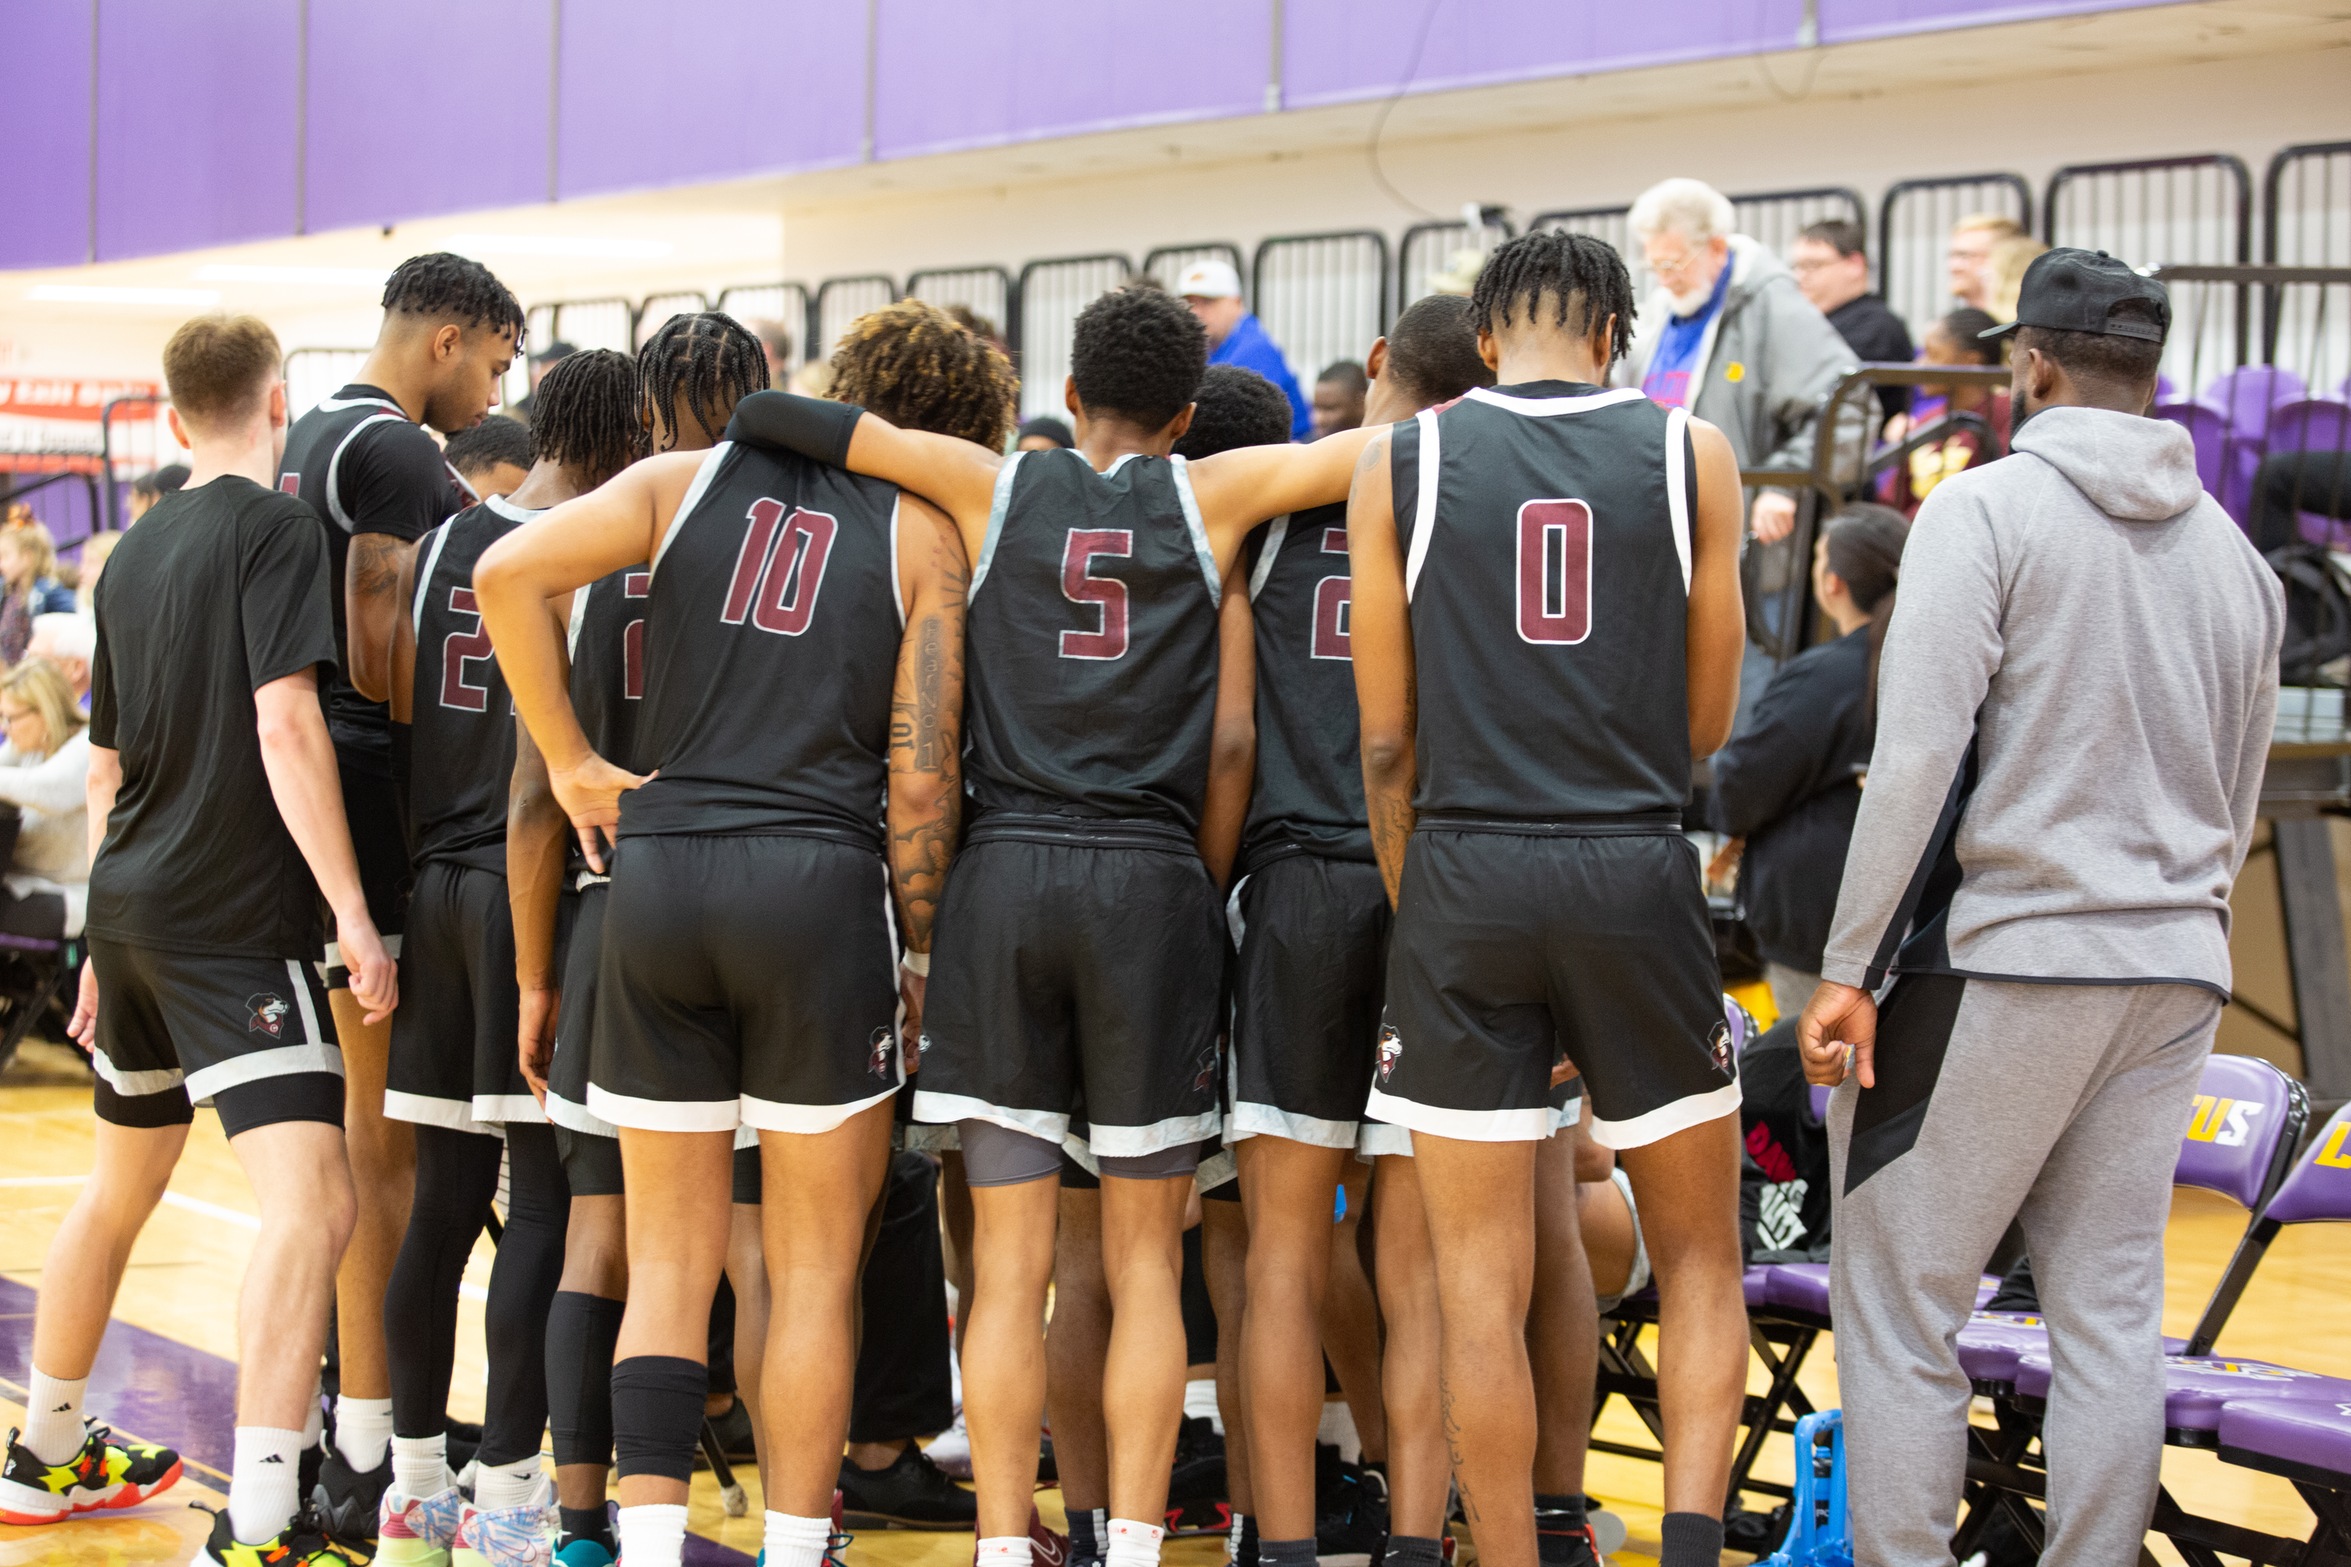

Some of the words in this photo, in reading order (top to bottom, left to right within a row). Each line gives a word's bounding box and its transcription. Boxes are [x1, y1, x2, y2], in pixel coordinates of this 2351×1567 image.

[720, 497, 838, 636] 10
[1058, 527, 1134, 660] 5
[1516, 498, 1593, 645] 0
[439, 586, 515, 716] 2
